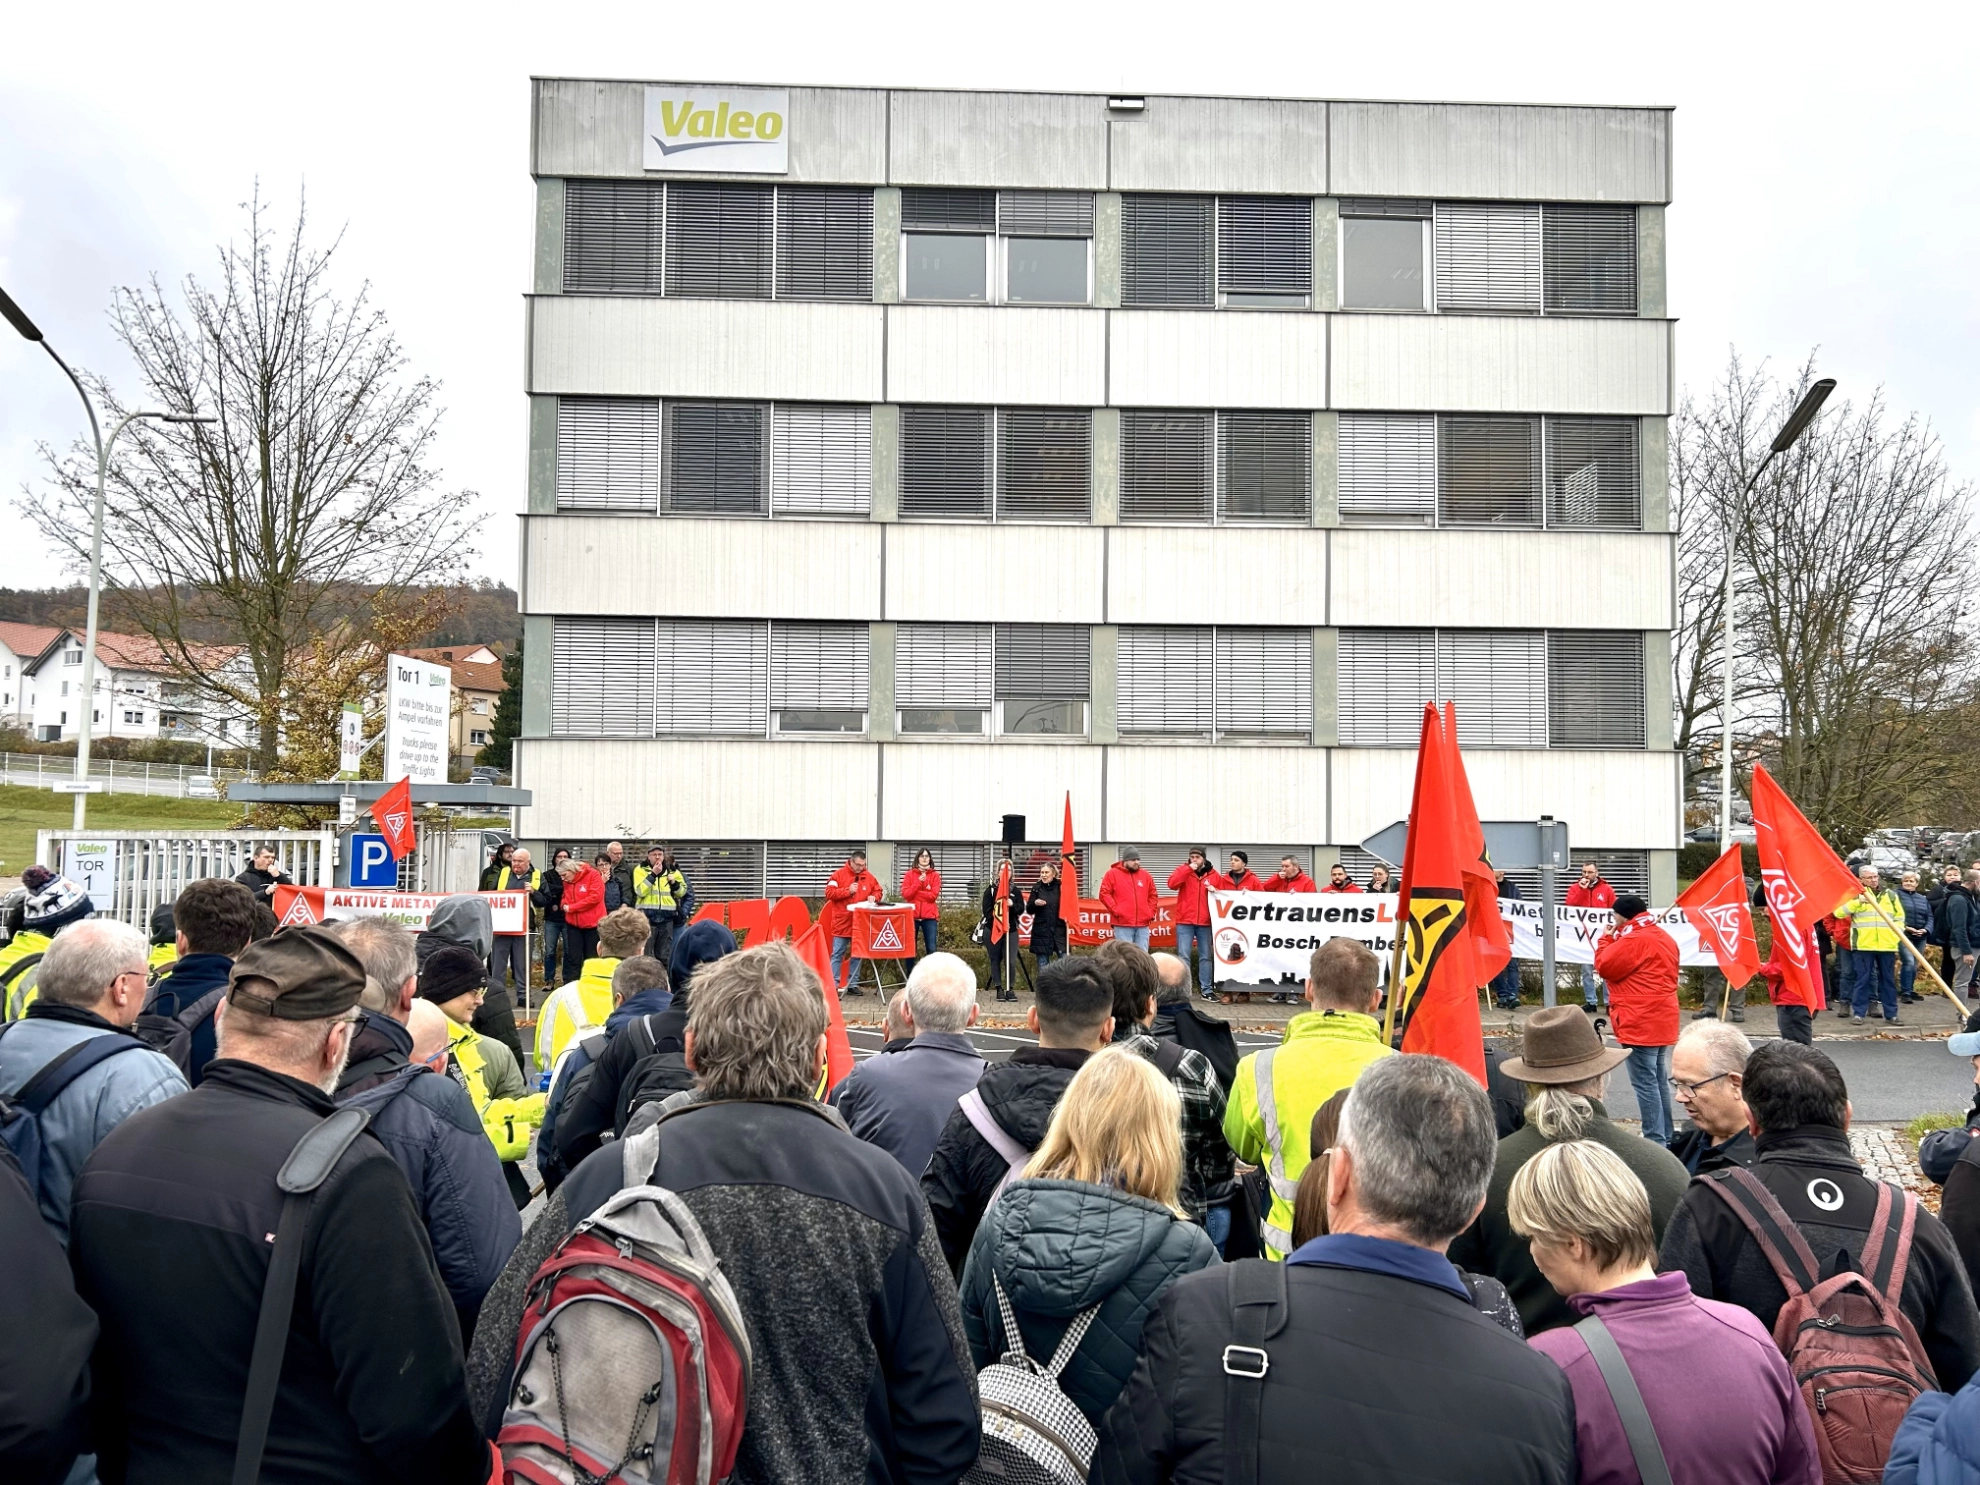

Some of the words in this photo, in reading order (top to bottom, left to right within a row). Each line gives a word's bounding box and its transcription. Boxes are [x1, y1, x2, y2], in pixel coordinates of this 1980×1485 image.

[661, 101, 783, 140] Valeo
[397, 666, 413, 683] Tor
[414, 670, 419, 684] 1
[429, 673, 446, 686] Valeo
[398, 698, 411, 708] LKW
[411, 699, 425, 711] bitte
[425, 701, 434, 713] bis
[434, 705, 443, 714] zur
[398, 711, 417, 724] Ampel
[417, 714, 443, 727] vorfahren
[402, 737, 419, 749] Trucks
[418, 739, 438, 752] please
[399, 750, 414, 761] drive
[414, 752, 422, 763] up
[423, 753, 429, 762] to
[429, 753, 439, 764] the
[402, 763, 419, 775] Traffic
[419, 765, 436, 778] Lights
[76, 843, 107, 853] Valeo
[76, 861, 104, 871] TOR
[361, 841, 388, 880] P
[83, 874, 92, 891] 1
[332, 894, 388, 909] AKTIVE
[1215, 899, 1398, 923] VertrauensL
[1148, 926, 1171, 936] echt
[1535, 924, 1560, 939] bi
[1257, 934, 1321, 950] Bosch
